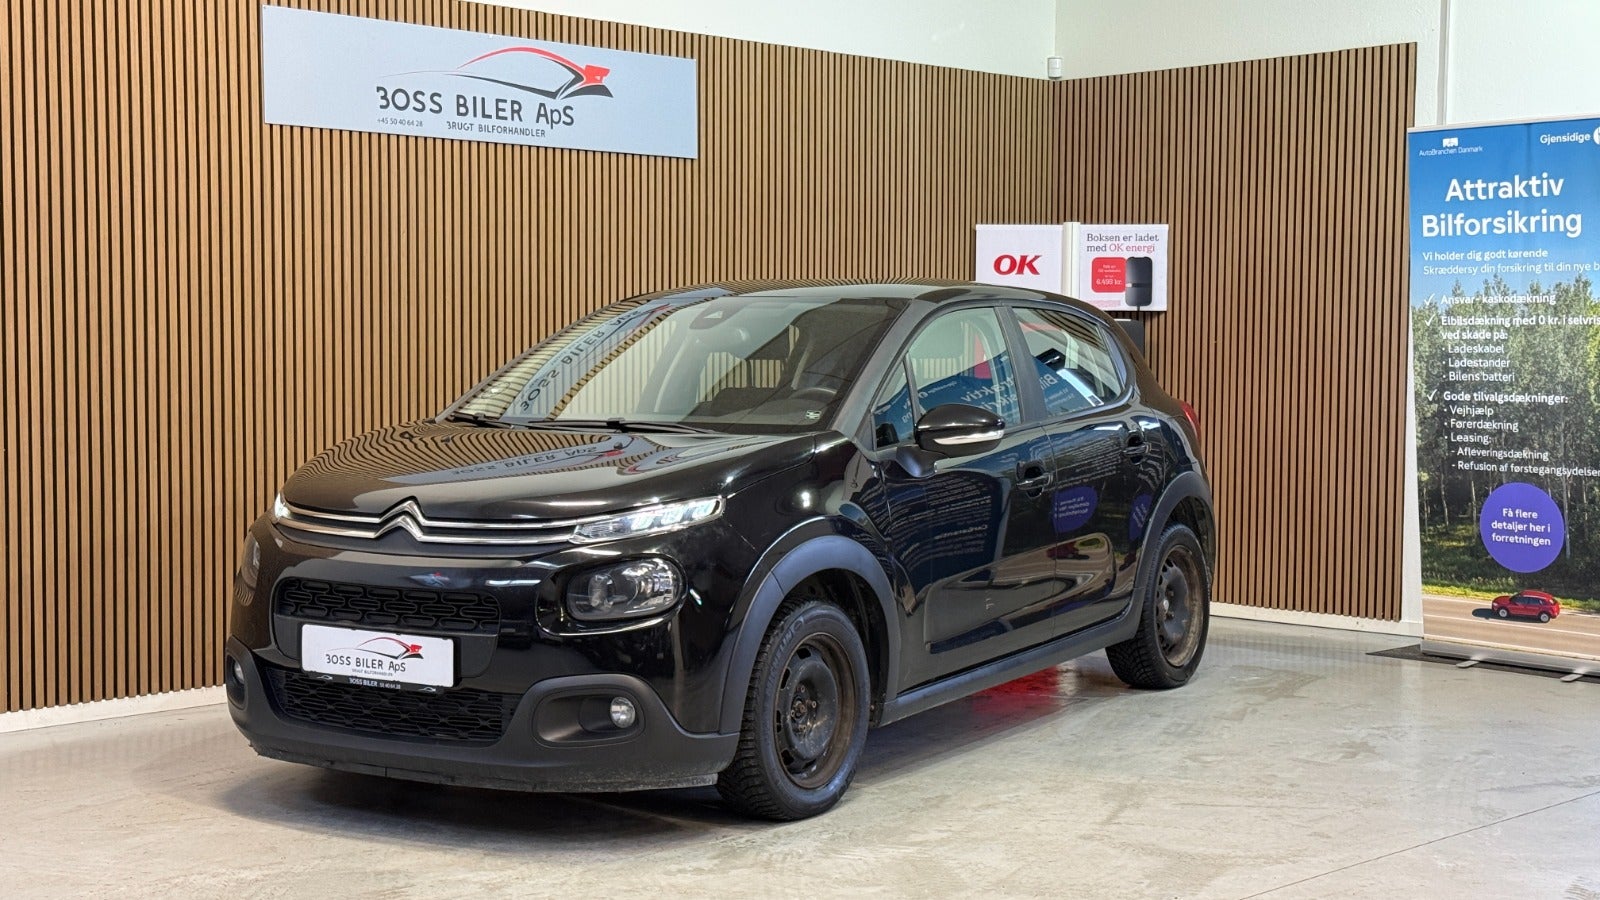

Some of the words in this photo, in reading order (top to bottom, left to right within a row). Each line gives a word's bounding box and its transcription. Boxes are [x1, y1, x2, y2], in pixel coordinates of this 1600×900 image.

[456, 94, 523, 122] BILER
[536, 102, 574, 130] ApS
[398, 118, 406, 126] 40
[478, 124, 546, 138] BILFORHANDLER
[1540, 131, 1591, 145] Gjensidige
[1419, 148, 1457, 157] AutoBranchen
[1458, 146, 1483, 154] Danmark
[1445, 172, 1564, 202] Attraktiv
[1422, 208, 1582, 238] Bilforsikring
[1087, 233, 1120, 242] Boksen
[1135, 233, 1160, 242] ladet
[1087, 244, 1107, 252] med
[1109, 244, 1124, 252] OK
[1125, 244, 1155, 254] energi
[1423, 252, 1433, 261] Vi
[1434, 251, 1465, 261] holder
[1467, 250, 1482, 262] dig
[1484, 250, 1506, 262] godt
[1508, 248, 1548, 259] kørende
[993, 254, 1043, 276] OK
[1423, 265, 1478, 276] Skræddersy
[1480, 263, 1495, 273] din
[1497, 262, 1541, 275] forsikring
[1543, 262, 1555, 272] til
[1556, 262, 1571, 272] din
[1573, 264, 1592, 275] nye
[1482, 293, 1556, 306] kaskodækning
[1441, 316, 1510, 327] Elbilsdækning
[1513, 316, 1536, 326] med
[1538, 316, 1546, 325] 0
[1548, 316, 1561, 325] kr.
[1441, 331, 1459, 340] ved
[1461, 331, 1491, 340] skade
[1493, 330, 1508, 342] på:
[1449, 345, 1504, 354] Ladeskabel
[1448, 358, 1510, 368] Ladestander
[1449, 372, 1479, 381] Bilens
[1482, 372, 1515, 382] batteri
[1443, 391, 1471, 401] Gode
[1473, 391, 1568, 406] tilvalgsdækninger:
[1450, 405, 1494, 416] Vejhjælp
[1450, 419, 1519, 432] Førerdækning
[1451, 433, 1491, 445] Leasing:
[1457, 447, 1549, 462] Afleveringsdækning
[1458, 461, 1497, 472] Refusion
[1499, 462, 1508, 472] af
[1503, 508, 1513, 518] Få
[1515, 509, 1538, 519] flere
[1491, 521, 1527, 532] detaljer
[1529, 523, 1546, 532] her
[1492, 533, 1551, 547] forretningen
[355, 657, 383, 670] BILER
[388, 661, 406, 673] ApS
[363, 679, 378, 687] BILER
